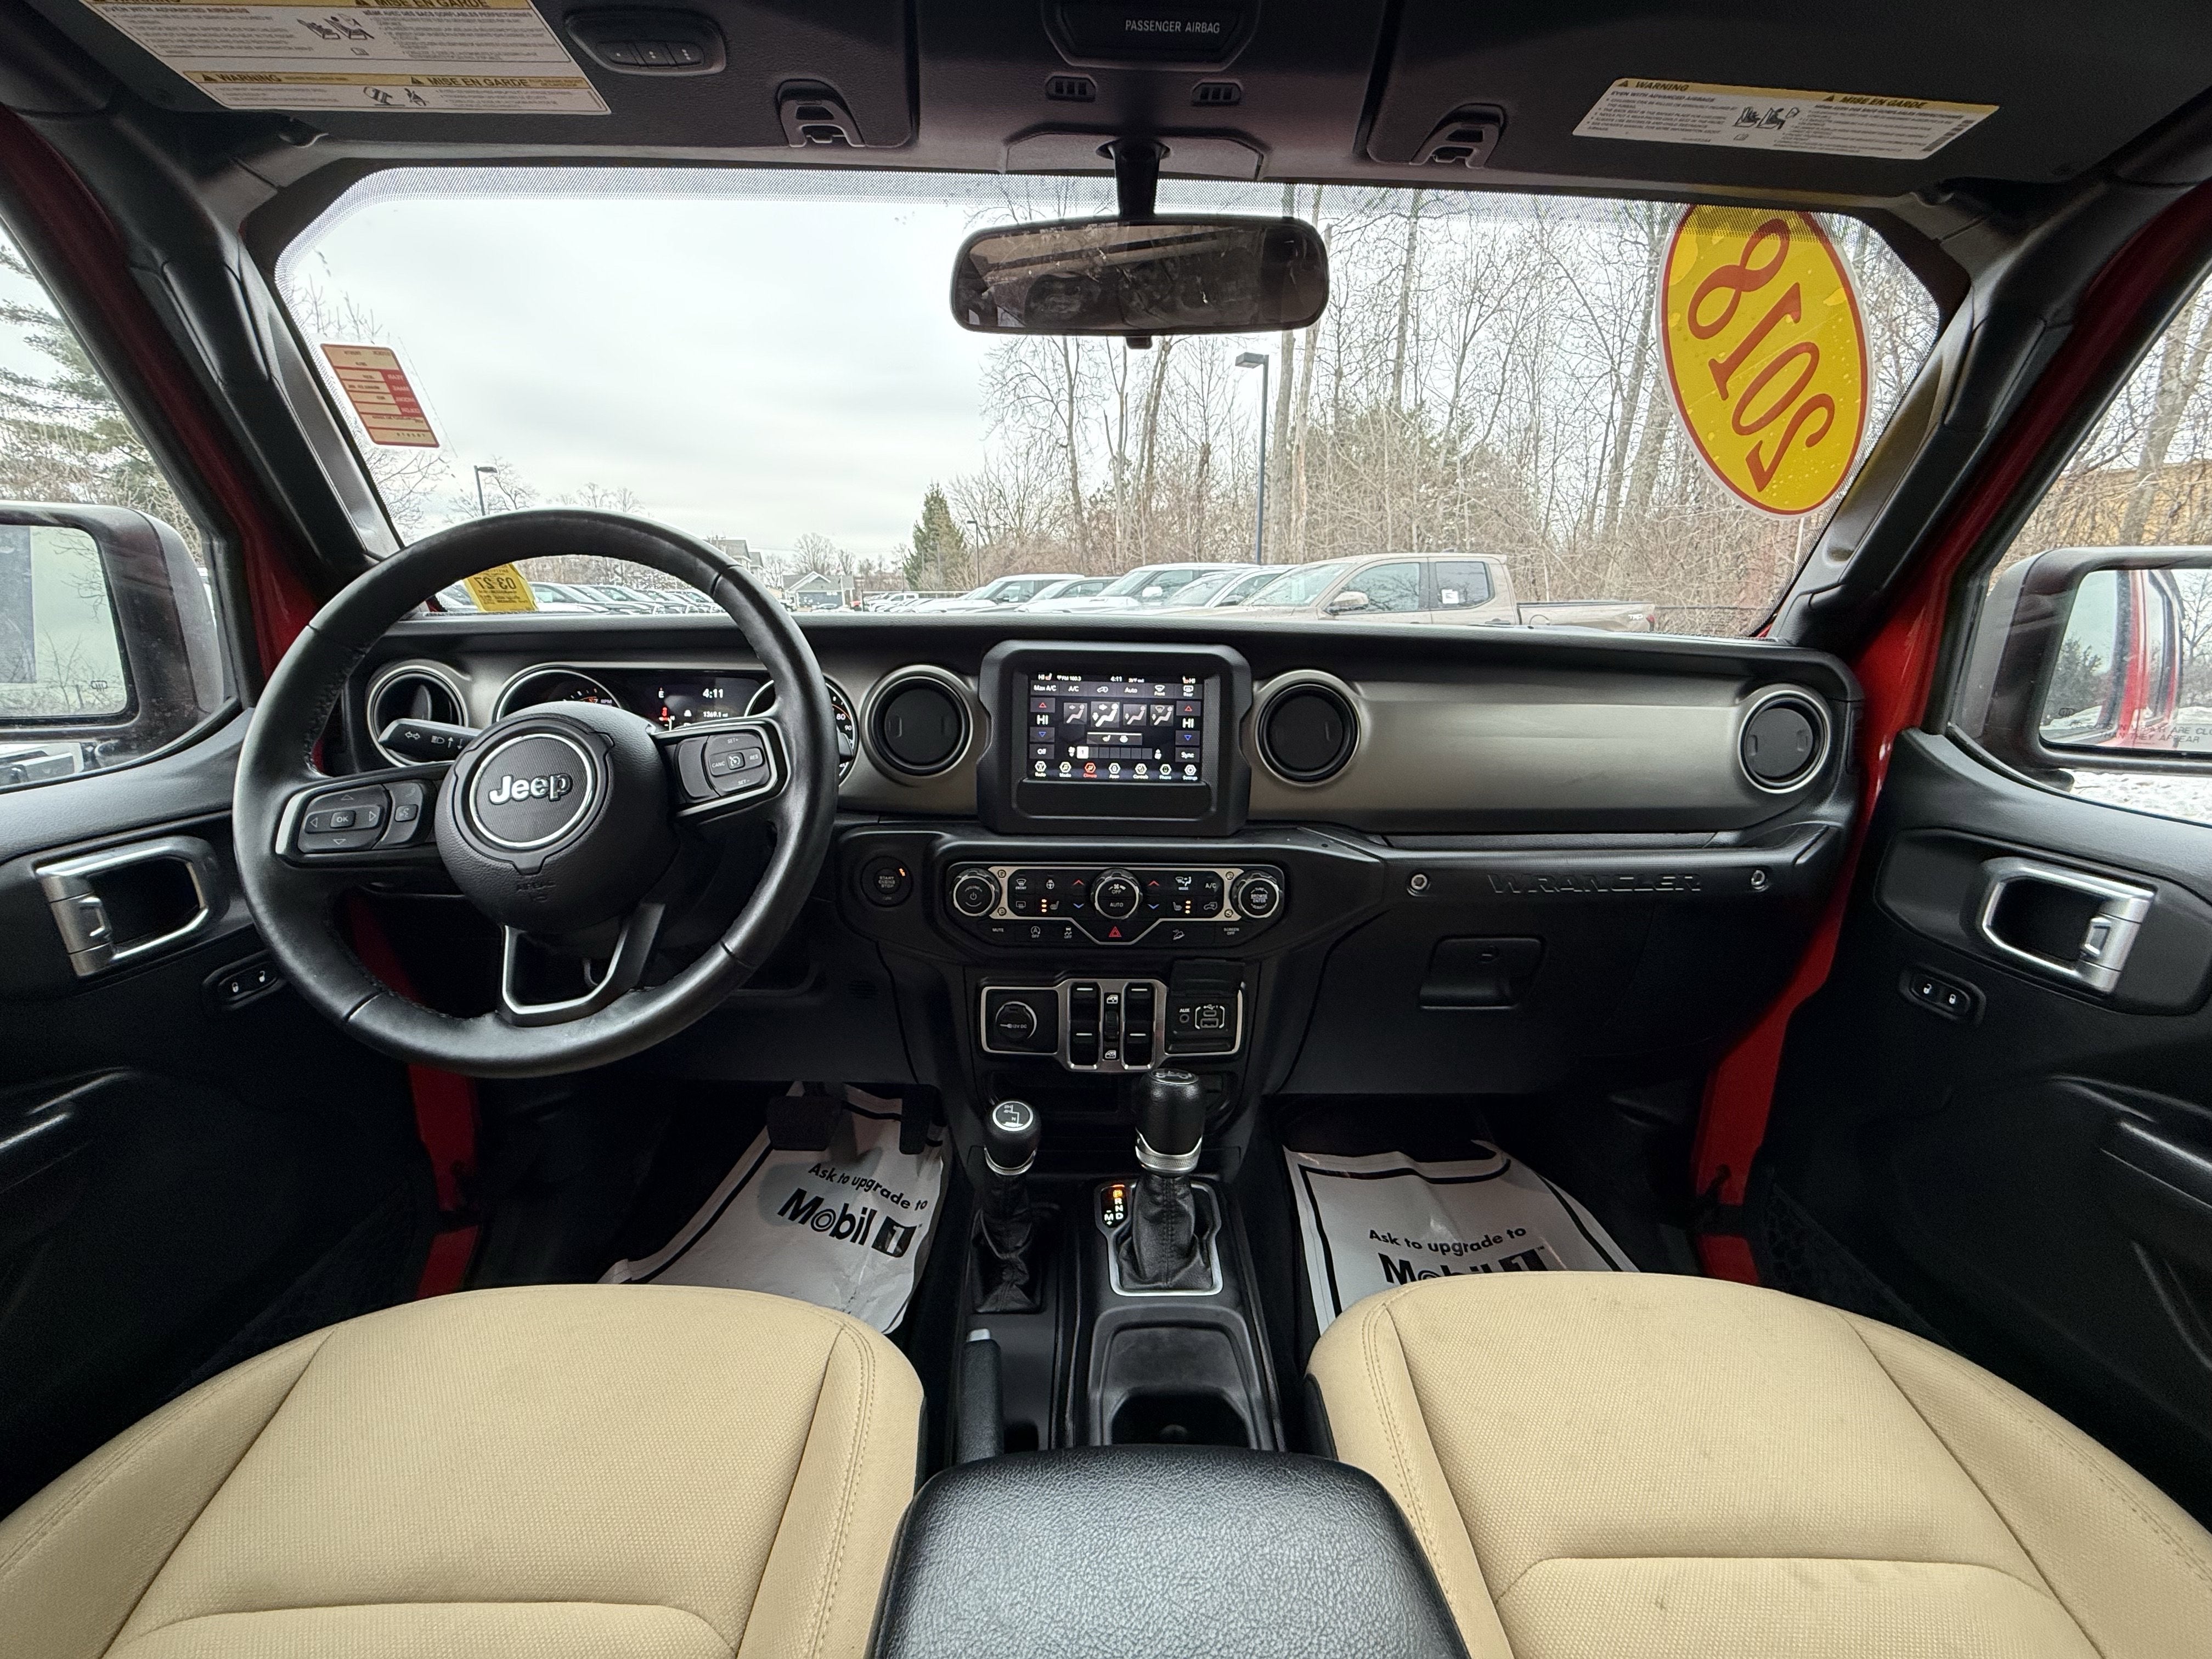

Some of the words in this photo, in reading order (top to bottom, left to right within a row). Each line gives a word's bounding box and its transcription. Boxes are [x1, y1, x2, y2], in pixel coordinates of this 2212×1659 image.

[1125, 20, 1182, 32] PASSENGER
[1186, 21, 1221, 34] AIRBAG
[216, 74, 282, 82] WARNING
[427, 77, 459, 86] MISE
[461, 78, 483, 86] EN
[483, 78, 529, 87] GARDE
[1635, 81, 1690, 92] WARNING
[1839, 96, 1870, 104] MISE
[1887, 100, 1928, 109] GARDE
[702, 688, 724, 699] 4:11
[1036, 714, 1049, 726] HI
[1182, 718, 1195, 729] HI
[1181, 751, 1195, 759] Sync
[489, 774, 573, 805] Jeep
[336, 815, 349, 823] OK
[1487, 873, 1701, 894] WRANGLER
[808, 1163, 838, 1182] Ask
[838, 1173, 850, 1184] to
[851, 1176, 911, 1210] upgrade
[914, 1200, 928, 1211] to
[1113, 1189, 1123, 1198] P
[777, 1187, 878, 1246] Mobil
[1104, 1213, 1114, 1221] M
[1115, 1212, 1124, 1220] D
[1369, 1229, 1401, 1246] Ask
[1405, 1237, 1423, 1250] to
[1427, 1234, 1504, 1257] upgrade
[1506, 1227, 1527, 1239] to
